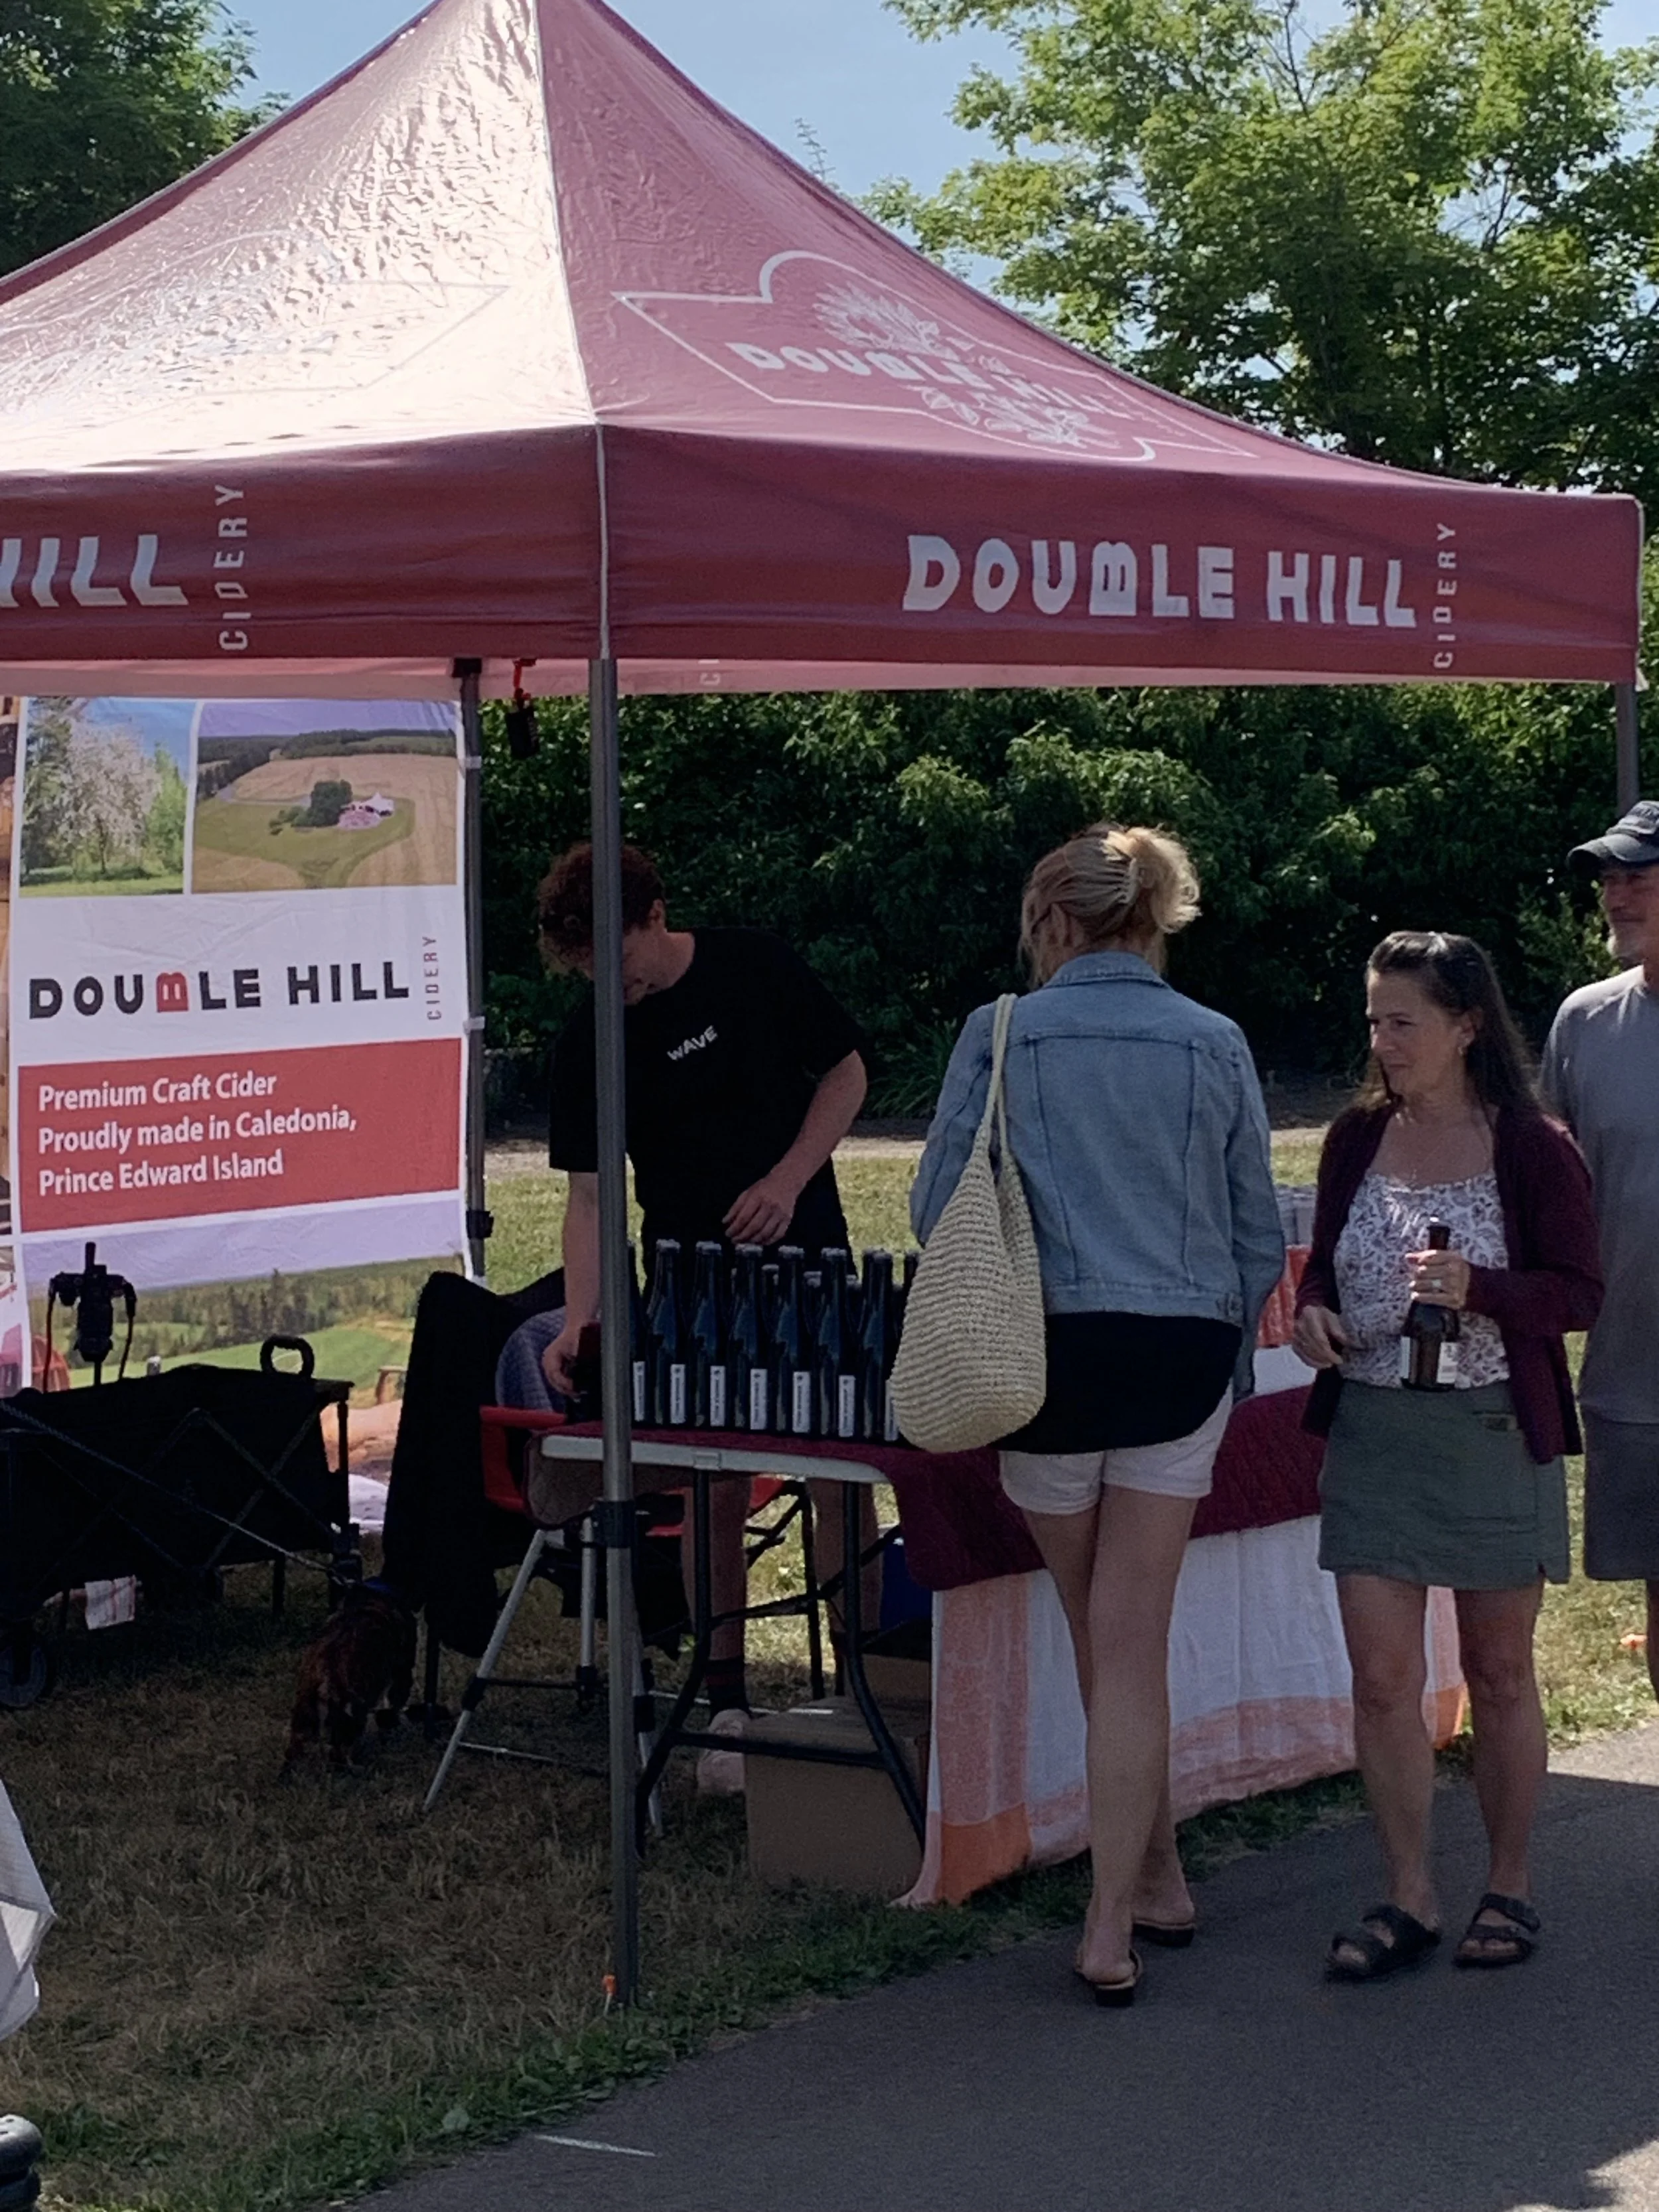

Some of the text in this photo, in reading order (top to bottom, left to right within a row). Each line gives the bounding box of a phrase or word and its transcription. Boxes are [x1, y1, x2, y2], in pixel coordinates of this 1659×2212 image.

[213, 484, 252, 650] CIDERY
[1267, 551, 1417, 628] HILL
[1433, 523, 1458, 668] CIDERY
[287, 961, 409, 1006] HILL
[422, 936, 442, 1020] CIDERY
[666, 1025, 718, 1061] WAVE
[39, 1070, 277, 1112] Premium Craft Cider
[38, 1104, 356, 1155] Proudly made in Caledonia,
[39, 1148, 284, 1197] Prince Edward Island
